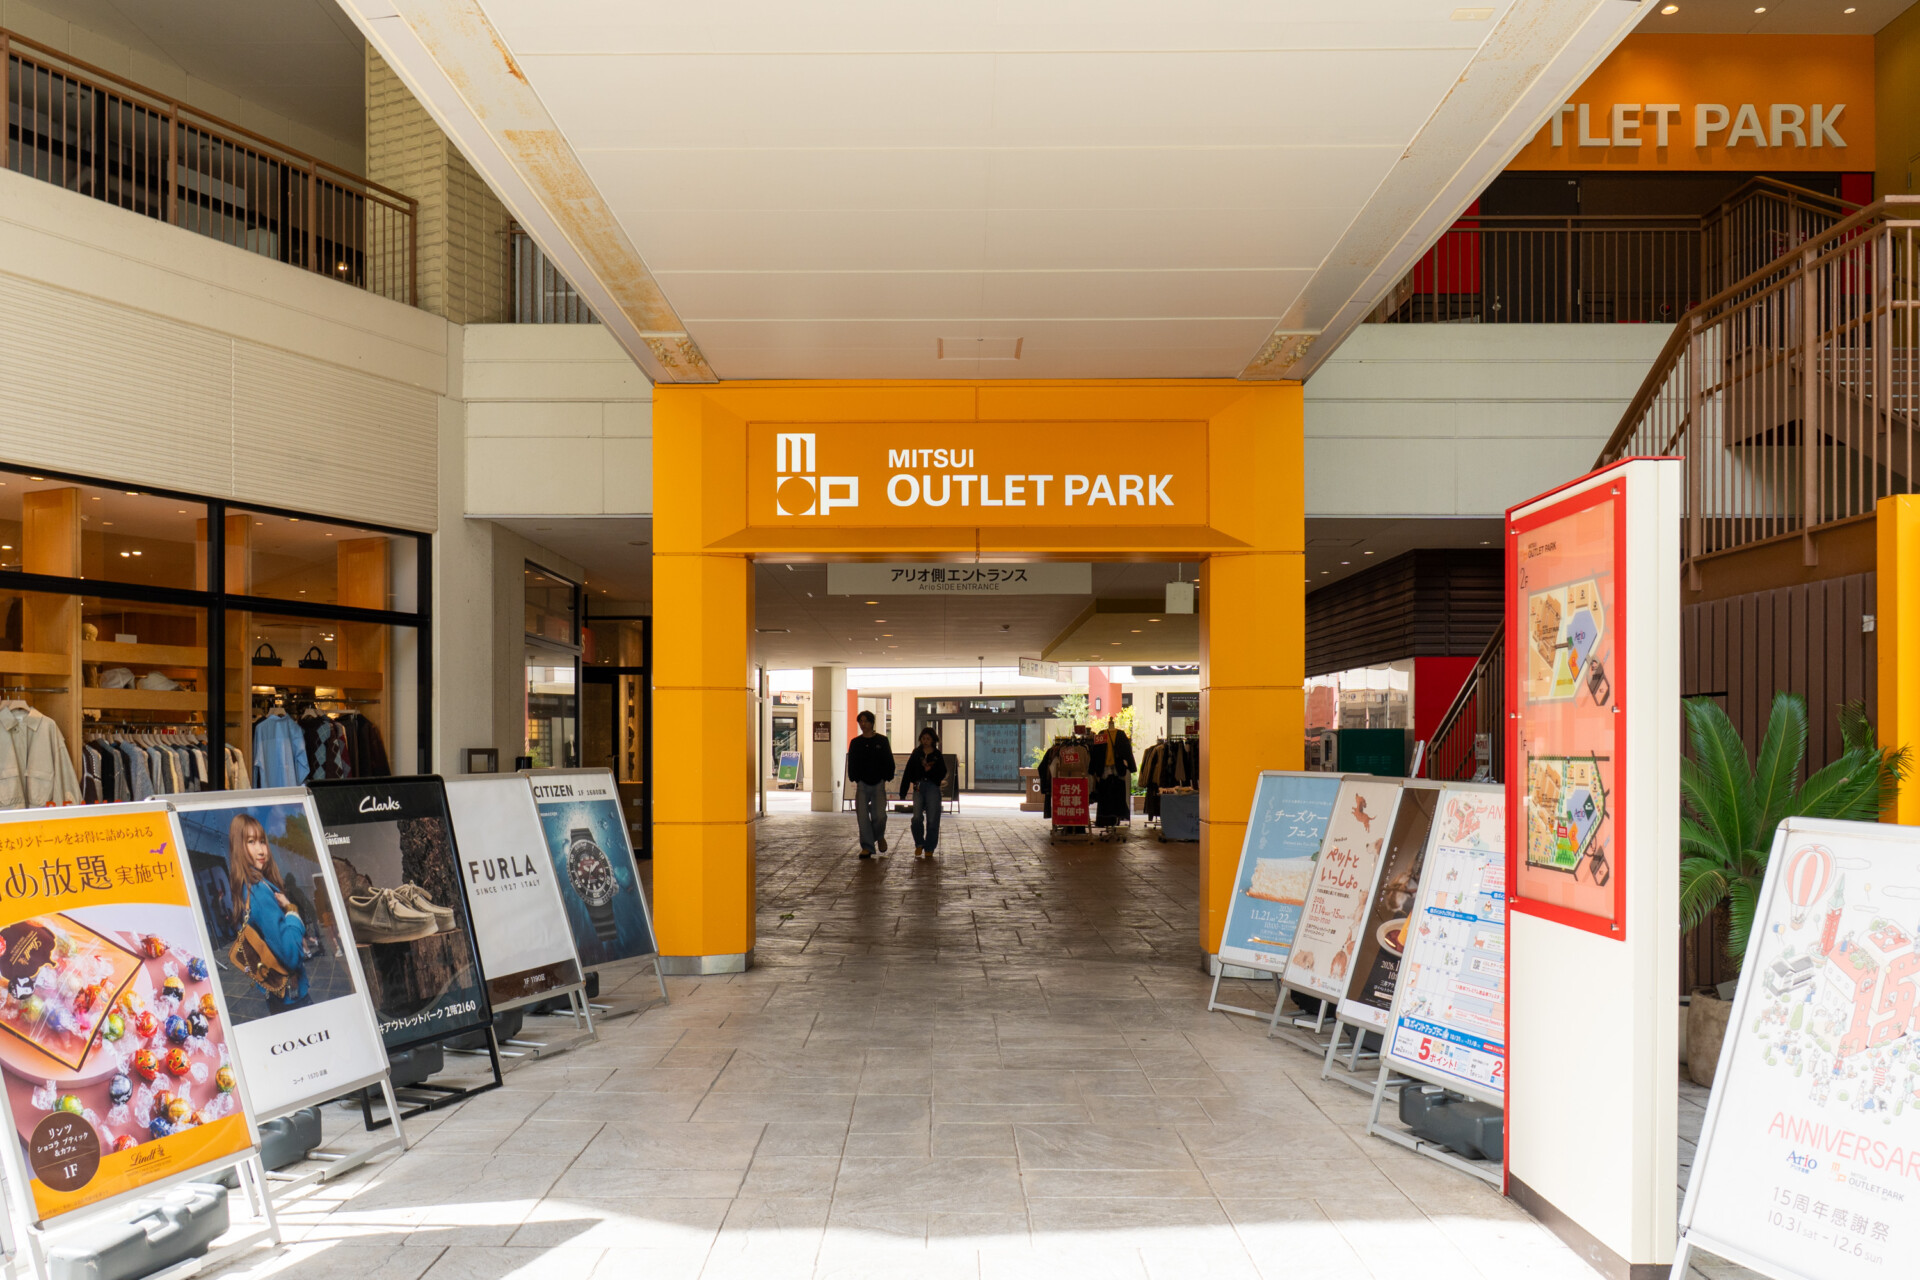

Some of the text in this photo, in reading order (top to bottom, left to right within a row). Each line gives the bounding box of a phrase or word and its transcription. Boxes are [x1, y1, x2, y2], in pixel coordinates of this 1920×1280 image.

[1526, 103, 1848, 148] TLET PARK
[888, 448, 975, 468] MITSUI
[887, 474, 1175, 507] OUTLET PARK
[891, 568, 1028, 583] アリオ側エントランス
[919, 583, 1000, 591] Ario SIDE ENTRANCE
[533, 785, 574, 798] CITIZEN
[1059, 784, 1082, 795] 店外
[359, 795, 401, 813] Clarks
[1059, 796, 1082, 807] 催事
[1057, 807, 1085, 817] 開催中
[1274, 809, 1329, 824] チーズケー
[1287, 826, 1318, 839] フェス
[1326, 848, 1360, 869] ペットと
[0, 855, 113, 900] め放題
[468, 854, 538, 884] FURLA
[1320, 867, 1359, 889] いっしょ。
[476, 879, 541, 896] SINCE 1927 ITALY
[270, 1029, 331, 1056] COACH
[1492, 1060, 1504, 1077] 2
[48, 1123, 73, 1140] リンツ
[37, 1131, 89, 1154] ショコラ ブティック
[54, 1146, 77, 1157] &カフェ
[130, 1148, 157, 1167] Lindt
[1786, 1150, 1818, 1170] Ario
[63, 1163, 78, 1179] 1F
[1848, 1177, 1881, 1194] OUTLET
[1882, 1188, 1905, 1202] PARK
[1773, 1186, 1890, 1243] 15周年感謝祭
[1803, 1228, 1818, 1240] sat
[1833, 1234, 1863, 1257] 12.6
[1864, 1252, 1884, 1265] sun
